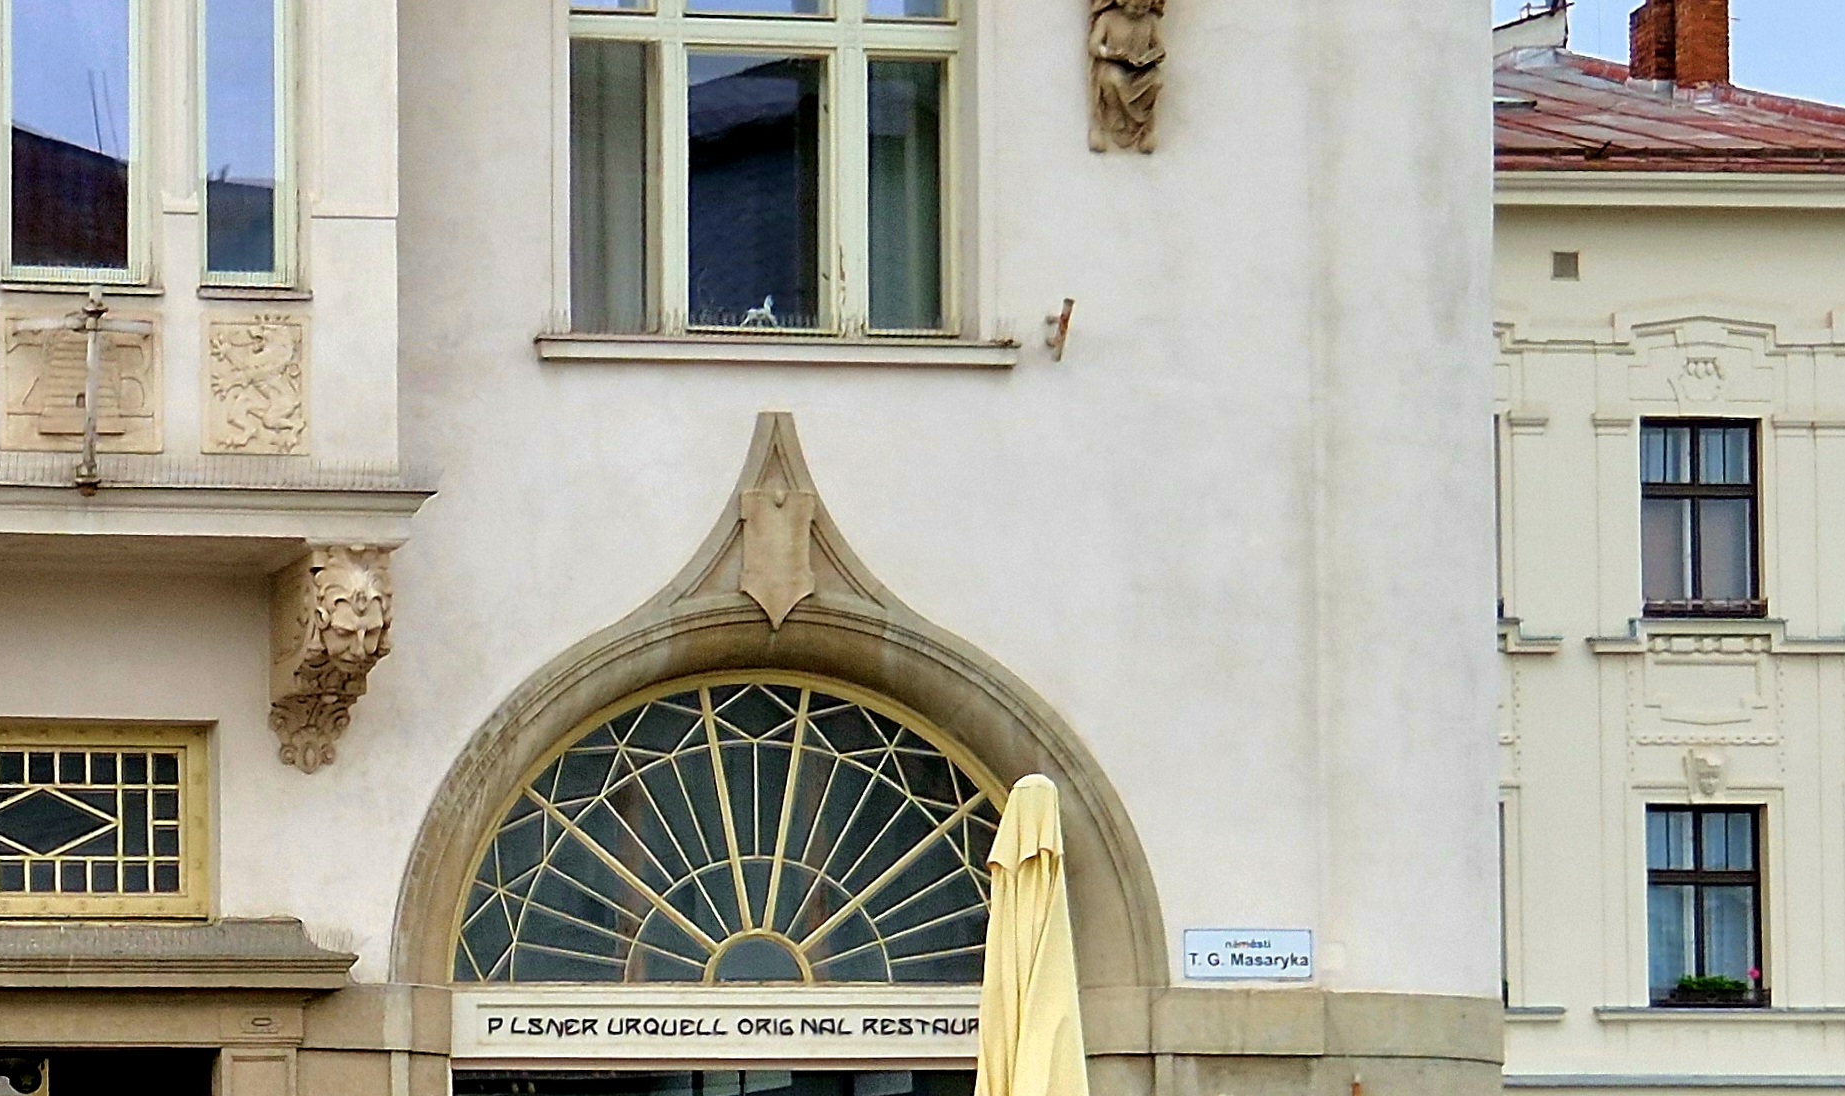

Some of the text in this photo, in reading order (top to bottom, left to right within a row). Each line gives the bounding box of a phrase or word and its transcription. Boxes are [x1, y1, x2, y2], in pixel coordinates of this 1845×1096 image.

[1189, 953, 1309, 970] T. G. Masaryka
[607, 1018, 728, 1035] URQUELL
[862, 1018, 979, 1035] RESTAUR
